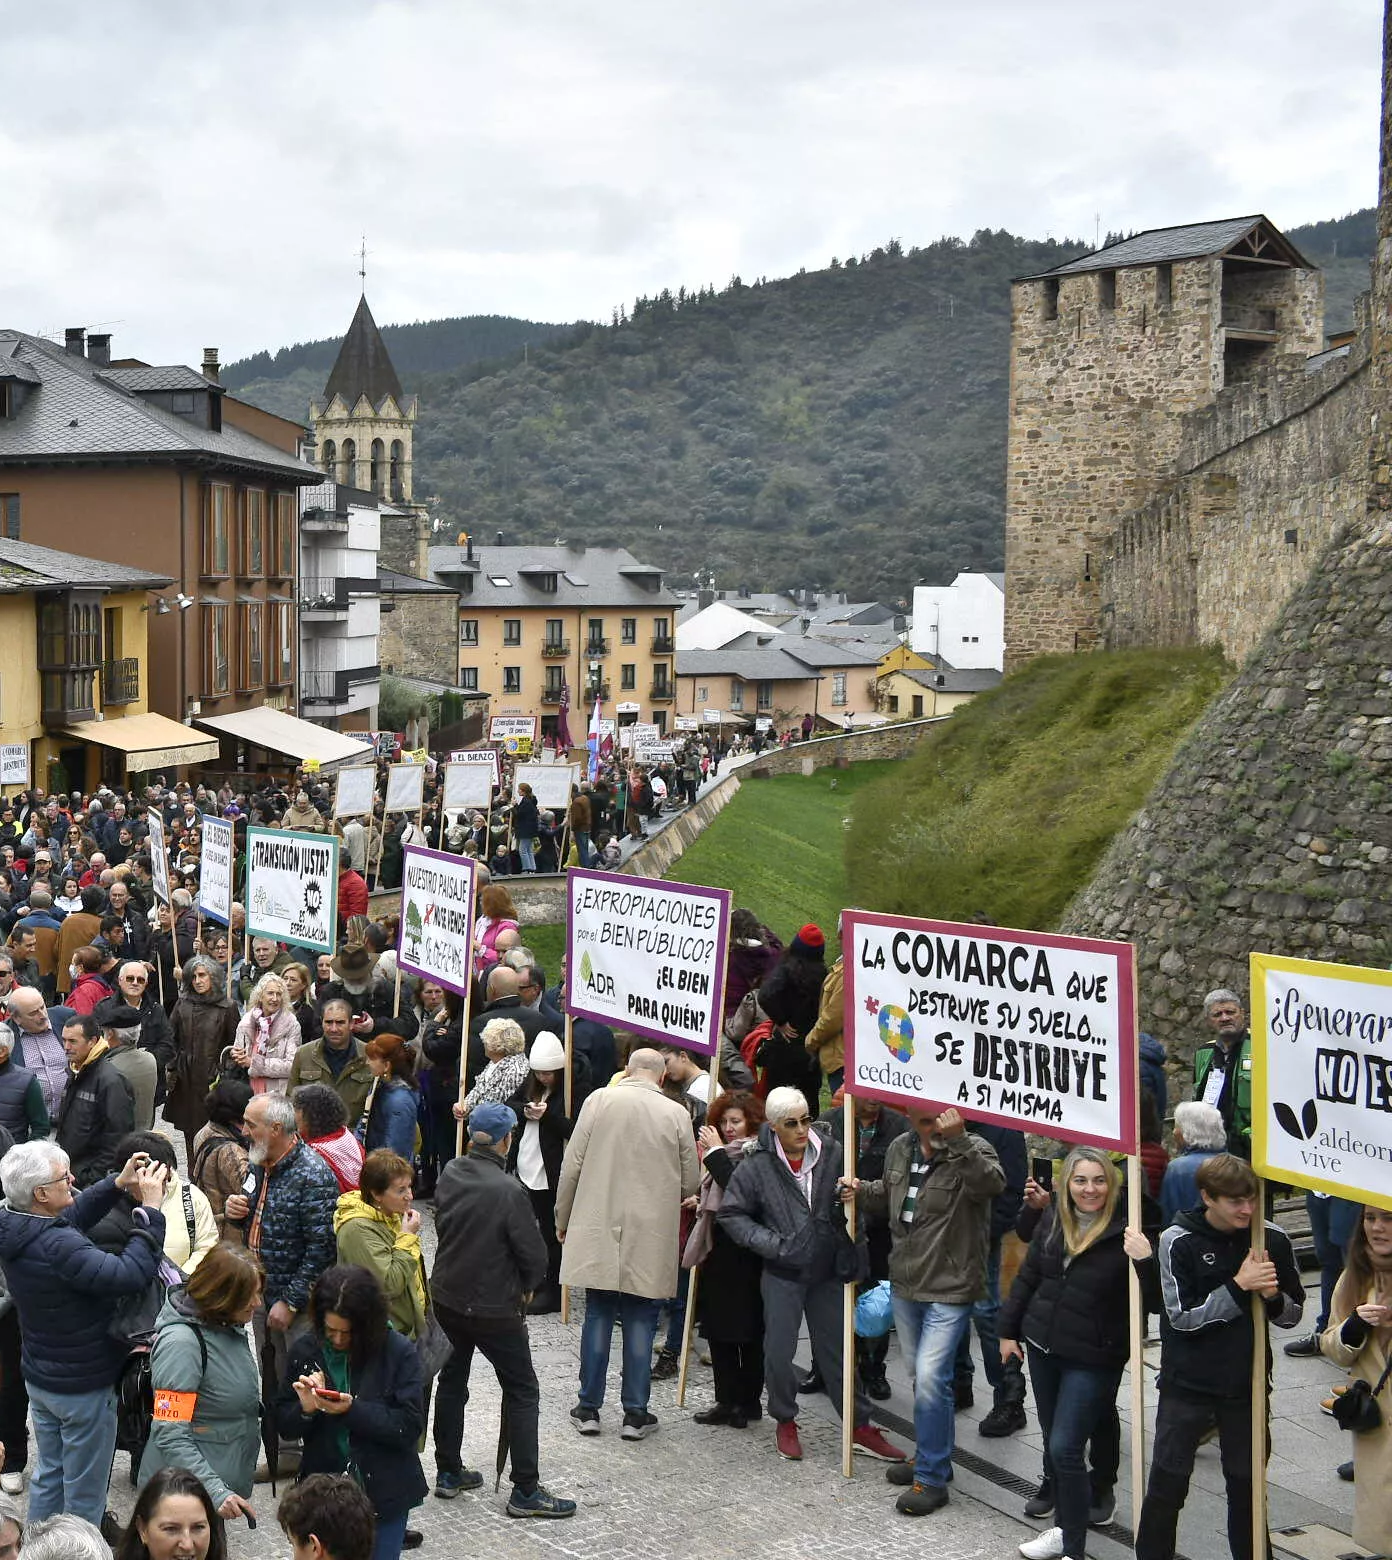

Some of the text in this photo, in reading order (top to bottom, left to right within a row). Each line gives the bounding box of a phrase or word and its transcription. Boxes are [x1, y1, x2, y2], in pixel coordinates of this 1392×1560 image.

[467, 752, 495, 762] BIERZO
[251, 838, 330, 880] ¿TRANSICIÓN JUSTA?
[407, 865, 468, 904] NUESTRO PAISAJE
[447, 908, 465, 937] VENDE
[575, 887, 716, 930] ¿EXPROPIACIONES
[577, 922, 715, 965] por el BIEN PÚBLICO?
[587, 972, 616, 998] ADR
[657, 966, 710, 996] ¿EL BIEN
[861, 931, 1109, 1003] LA COMARCA QUE
[627, 993, 658, 1021] PARA
[661, 1002, 706, 1033] QUIÉN?
[908, 987, 1108, 1047] DESTRUYE SU SUELO...
[858, 1062, 925, 1092] cedace
[934, 1031, 1108, 1102] SE DESTRUYE
[1317, 1050, 1356, 1103] NO
[957, 1080, 1063, 1123] A SI MISMA
[1300, 1145, 1343, 1174] vive
[169, 1394, 180, 1403] EL
